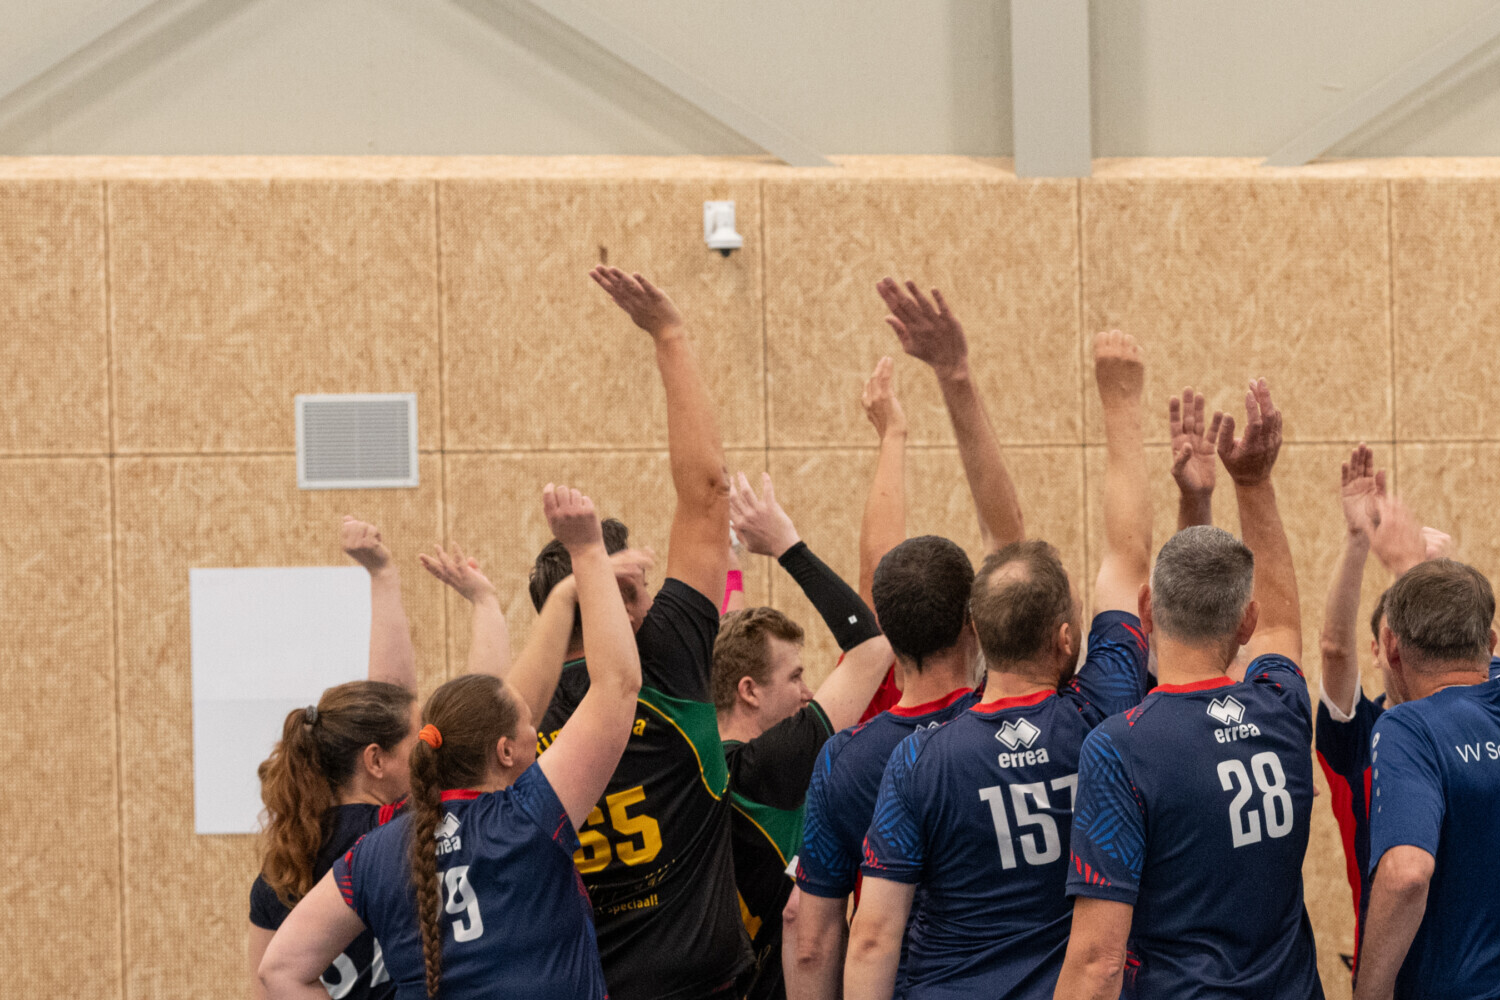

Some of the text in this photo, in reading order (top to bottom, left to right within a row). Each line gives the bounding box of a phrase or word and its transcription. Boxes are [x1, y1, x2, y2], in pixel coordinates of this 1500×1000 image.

[1214, 723, 1261, 744] errea
[998, 748, 1049, 768] errea
[1456, 743, 1480, 763] VV
[1217, 751, 1294, 848] 28
